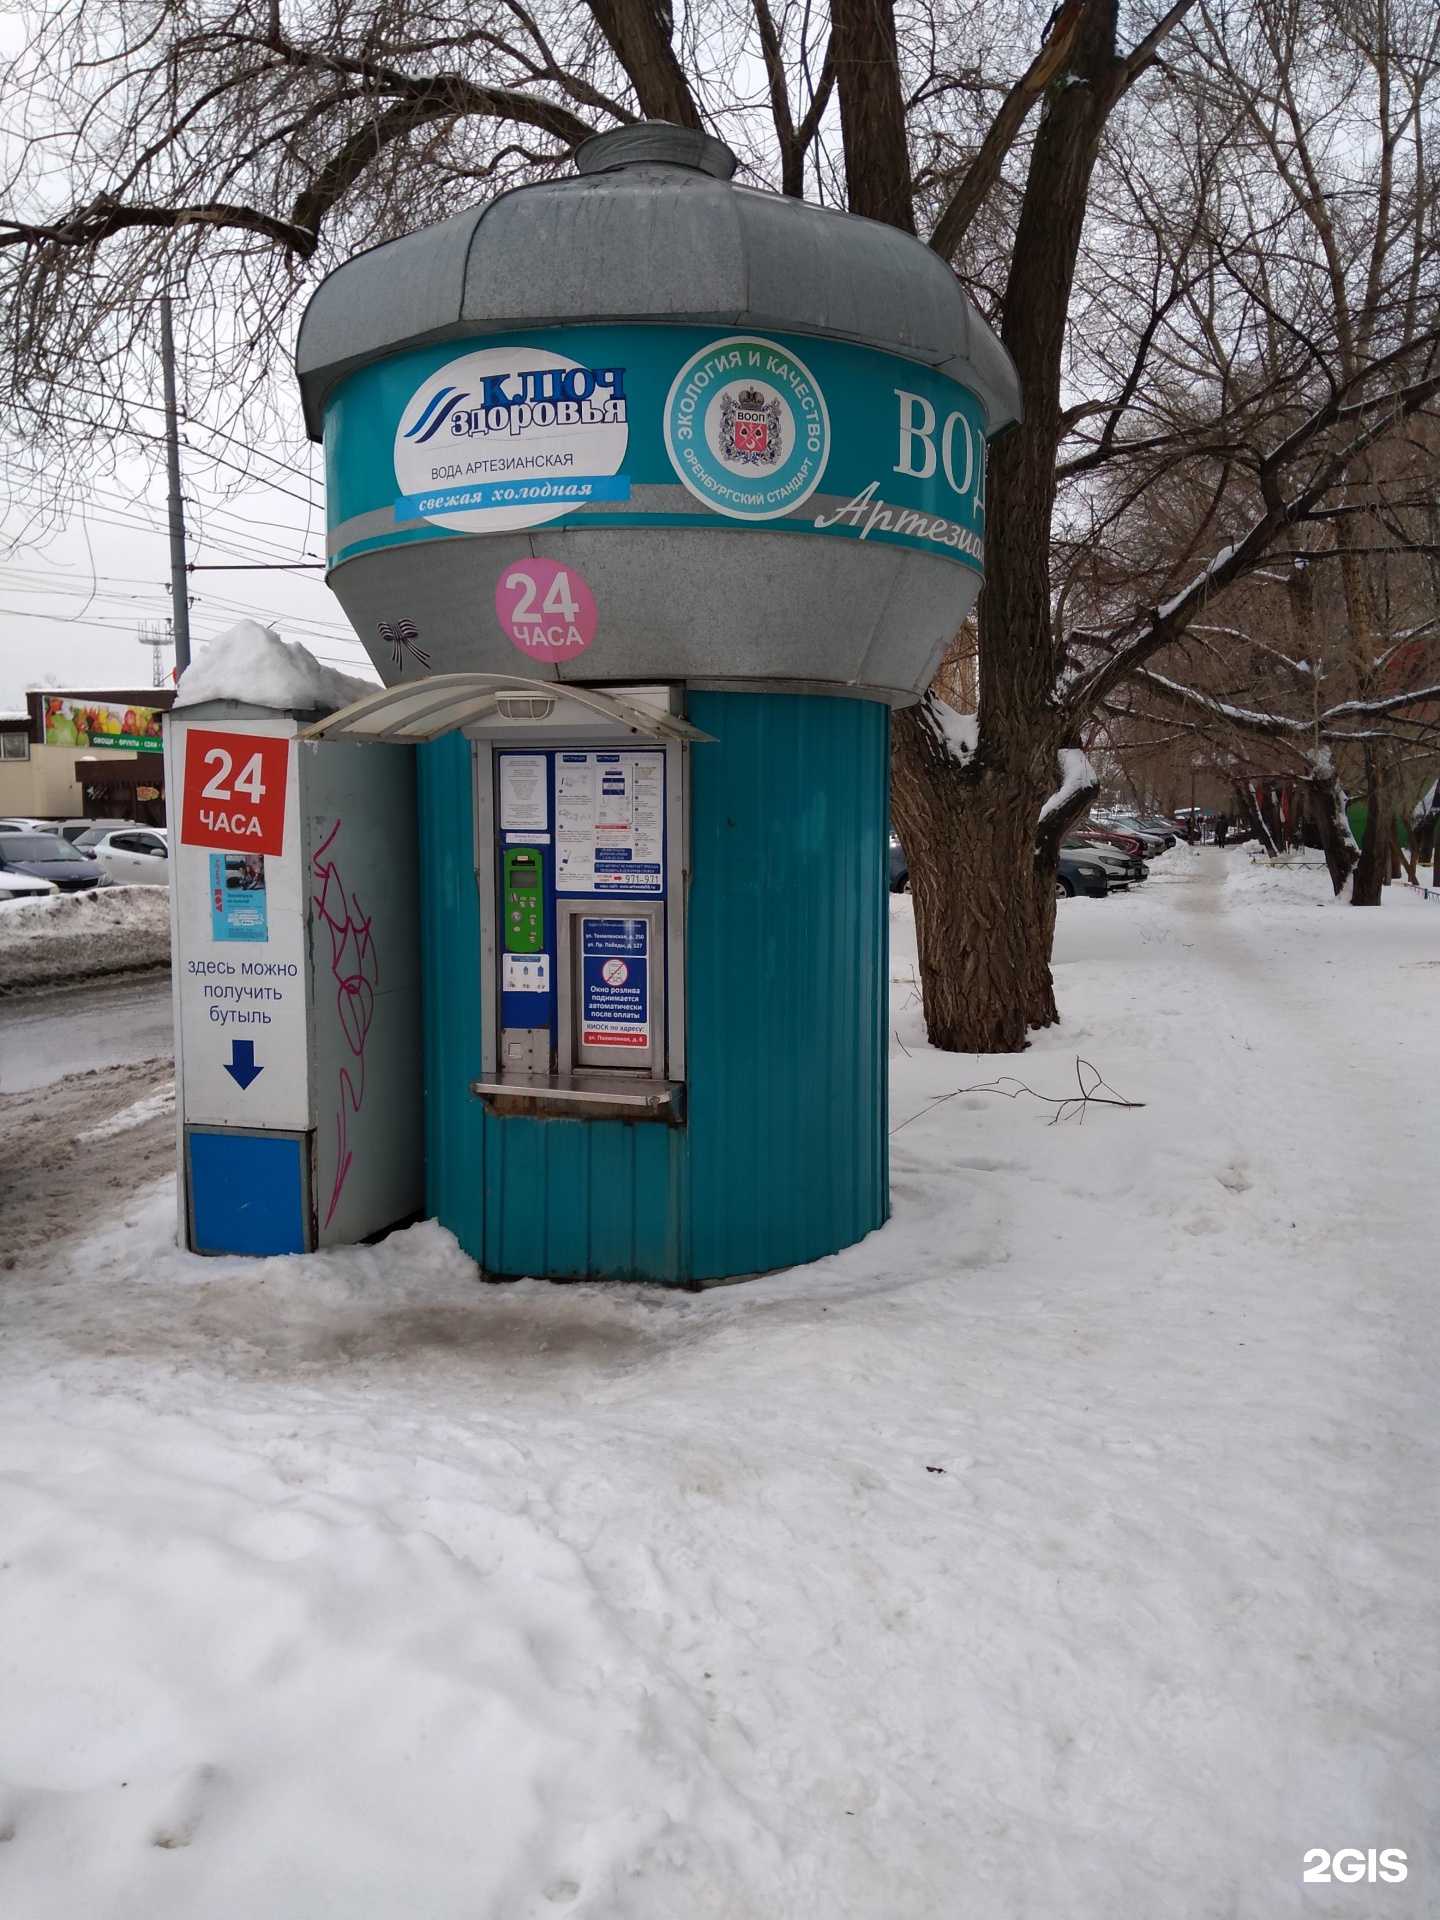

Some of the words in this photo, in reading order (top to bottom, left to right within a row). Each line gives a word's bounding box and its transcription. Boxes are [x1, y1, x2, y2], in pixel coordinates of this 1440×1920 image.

[479, 367, 627, 409] КЛЮЧ
[677, 351, 742, 440] ЭКОЛОГИЯ
[749, 350, 761, 367] И
[766, 355, 821, 452] КАЧЕСТВО
[450, 399, 628, 437] здоровья
[737, 412, 766, 423] ВООП
[431, 463, 463, 480] ВОДА
[465, 453, 575, 475] АРТЕЗИАНСКАЯ
[683, 447, 765, 505] ОРЕНБУРГСКИЙ
[766, 457, 814, 504] СТАНДАРТ
[418, 491, 483, 512] свежая
[491, 481, 593, 502] холодная
[504, 571, 581, 623] 24
[512, 625, 585, 647] ЧАСА
[201, 748, 266, 805] 24
[199, 808, 264, 838] ЧАСА
[188, 960, 236, 976] здесь
[241, 962, 298, 977] можно
[204, 985, 282, 1003] получить
[590, 985, 610, 993] Окно
[591, 995, 640, 1003] поднимается
[209, 1005, 272, 1026] бутыль
[586, 1023, 609, 1031] КИОСК
